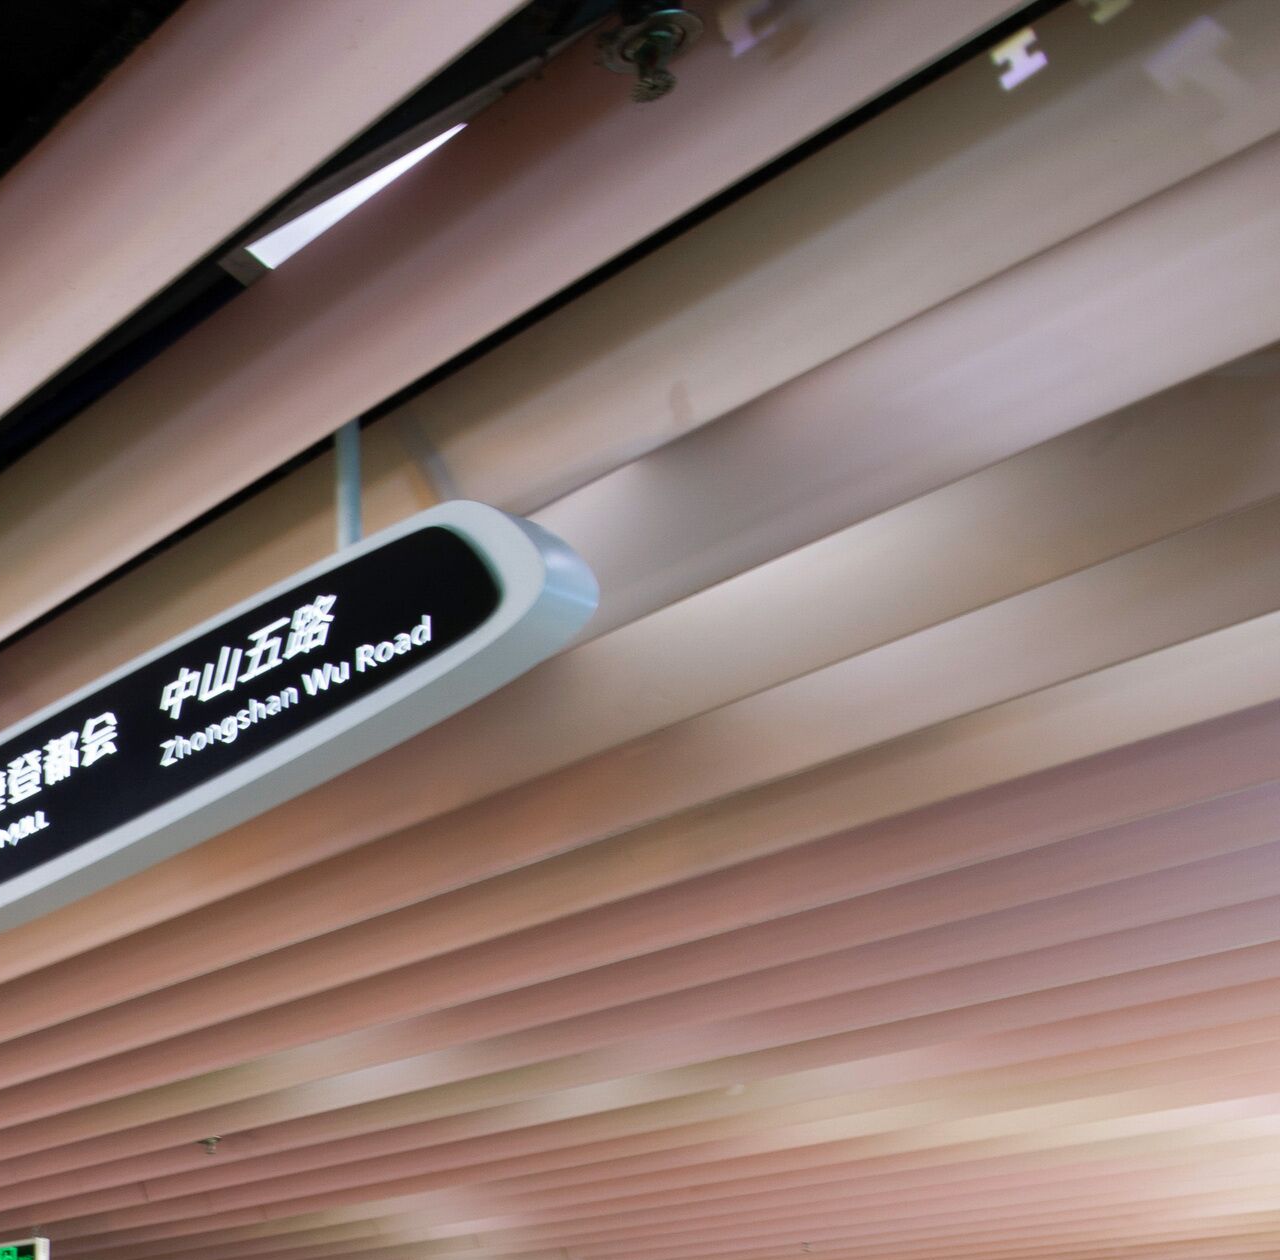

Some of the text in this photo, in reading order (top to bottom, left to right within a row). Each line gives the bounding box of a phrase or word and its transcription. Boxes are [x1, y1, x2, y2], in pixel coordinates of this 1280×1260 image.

[159, 594, 337, 720] 中山五路
[159, 614, 432, 767] Zhongshan Wu Road
